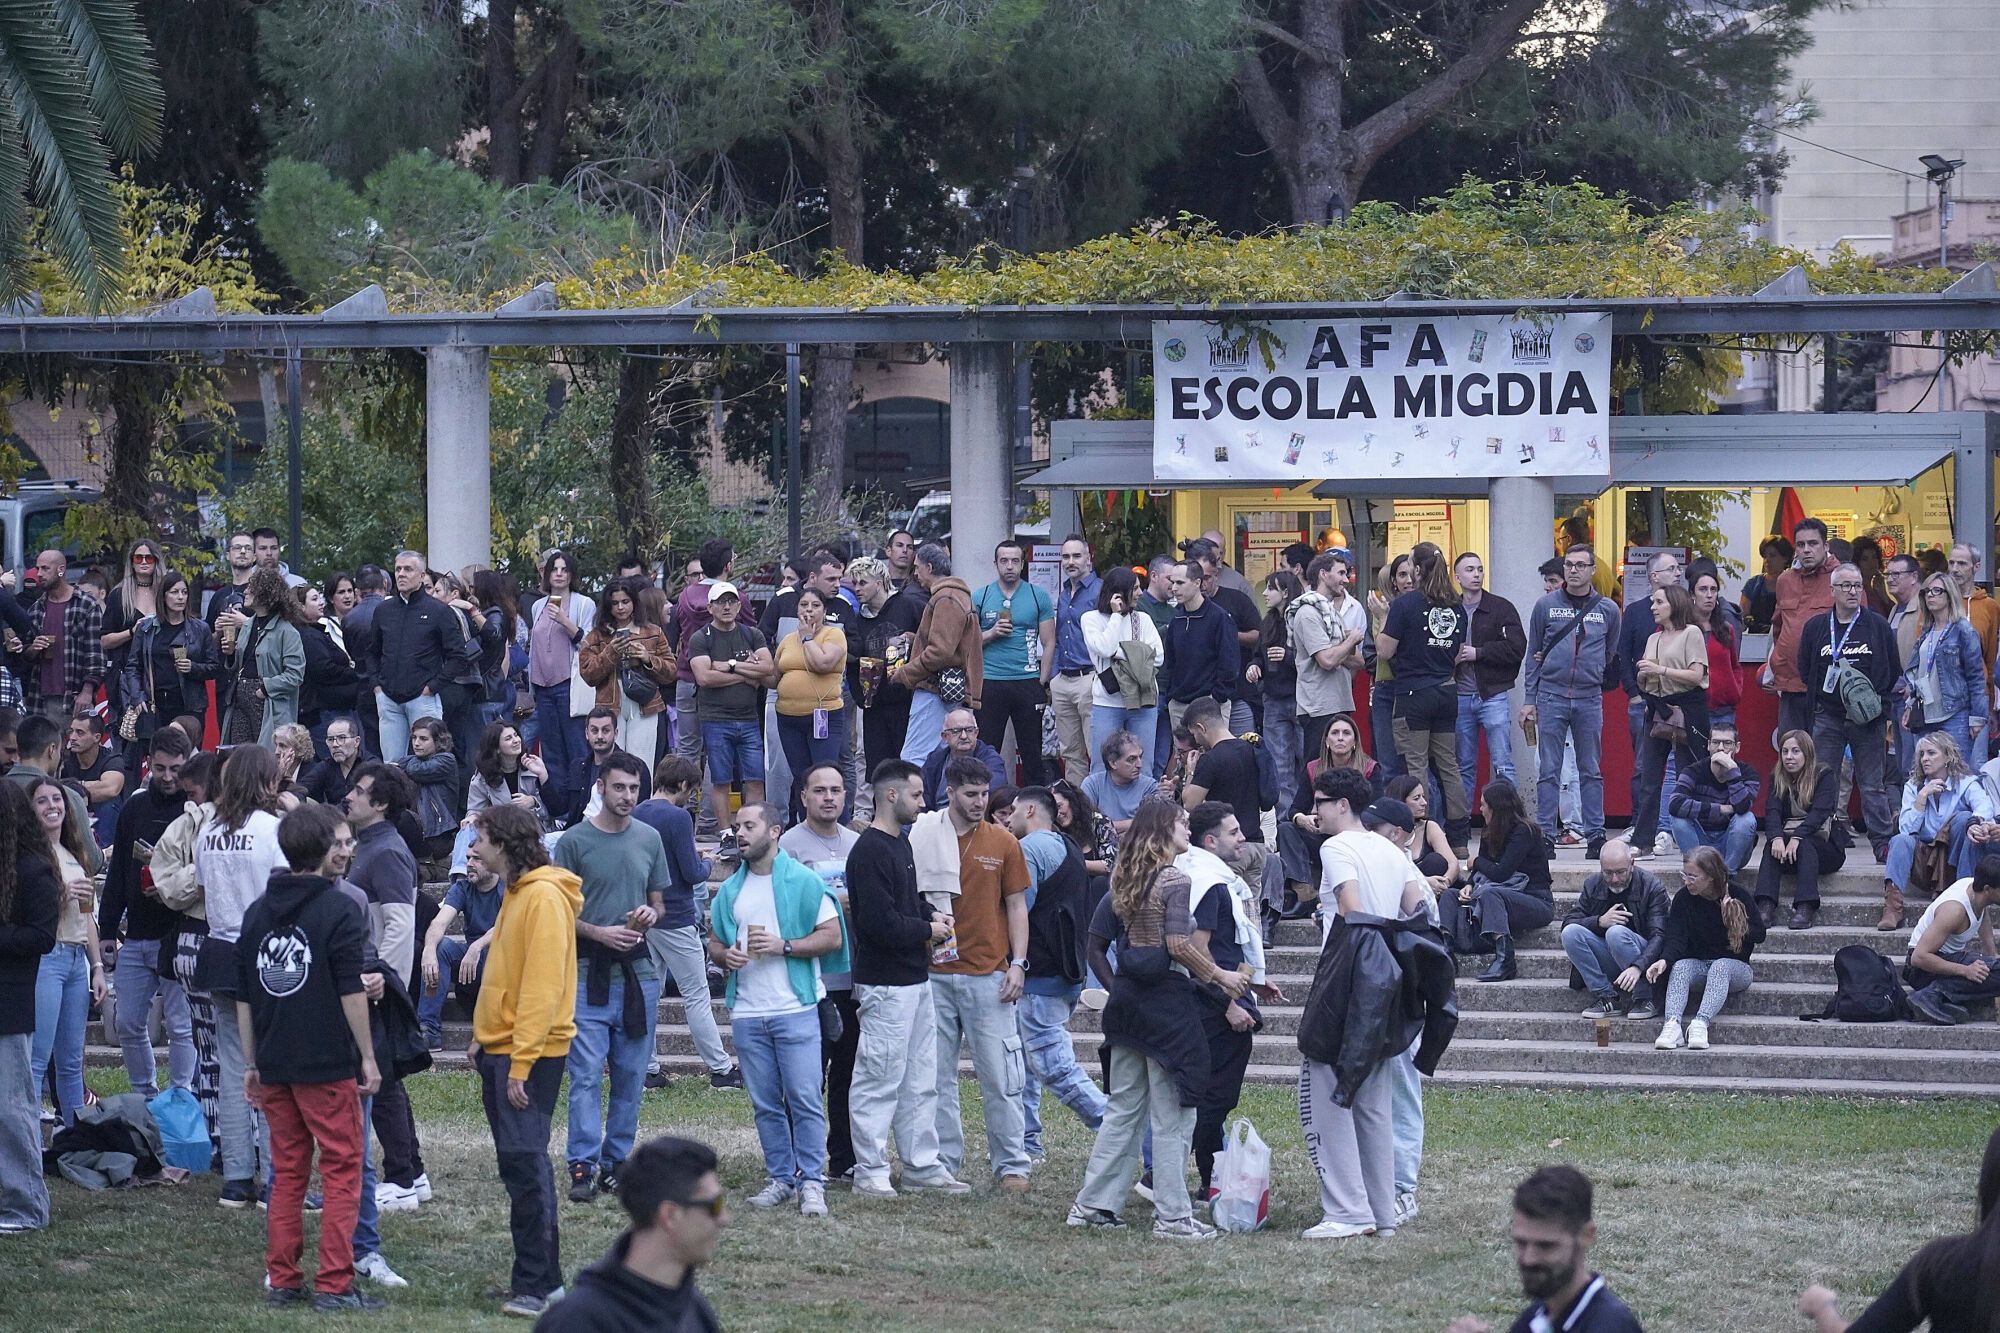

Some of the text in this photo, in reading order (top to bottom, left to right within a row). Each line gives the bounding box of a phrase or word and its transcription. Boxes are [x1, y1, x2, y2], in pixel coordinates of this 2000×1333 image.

[1305, 324, 1448, 370] AFA
[1171, 370, 1598, 421] ESCOLA MIGDIA
[203, 834, 254, 851] MORE
